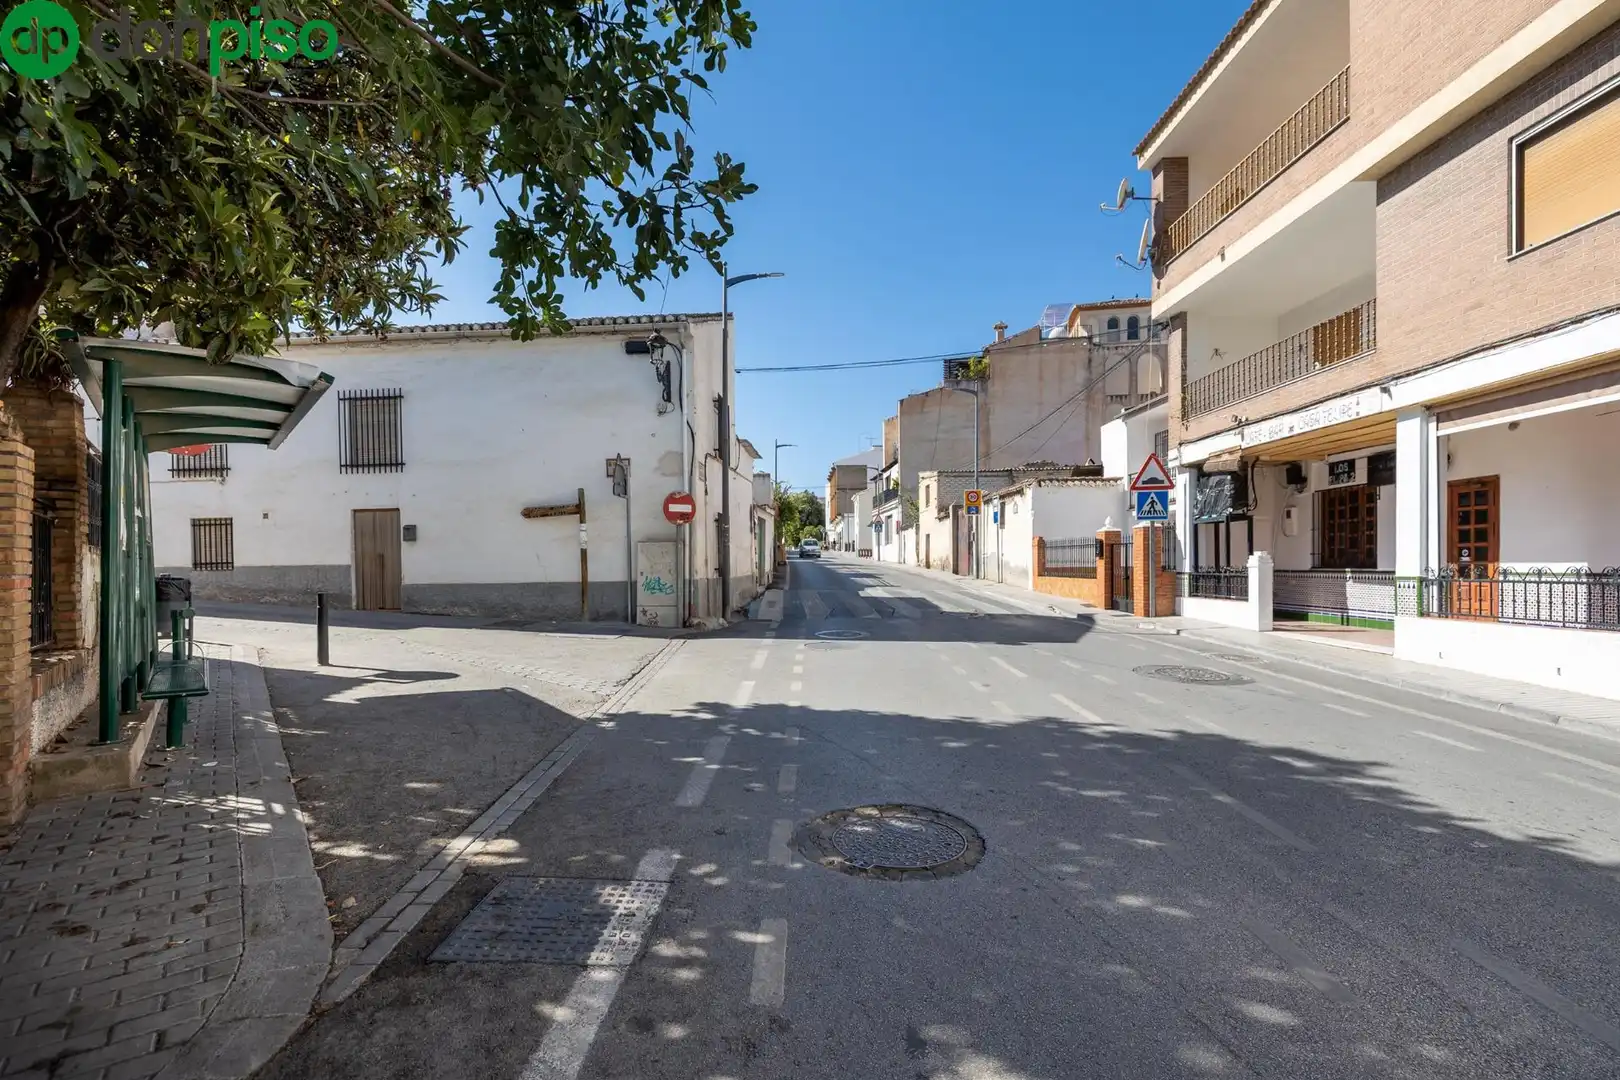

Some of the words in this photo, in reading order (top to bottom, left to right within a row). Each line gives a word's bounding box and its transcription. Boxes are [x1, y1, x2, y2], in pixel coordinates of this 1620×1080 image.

[1299, 411, 1321, 430] CASA
[1322, 401, 1353, 425] FELIPE
[1334, 462, 1349, 474] LOS
